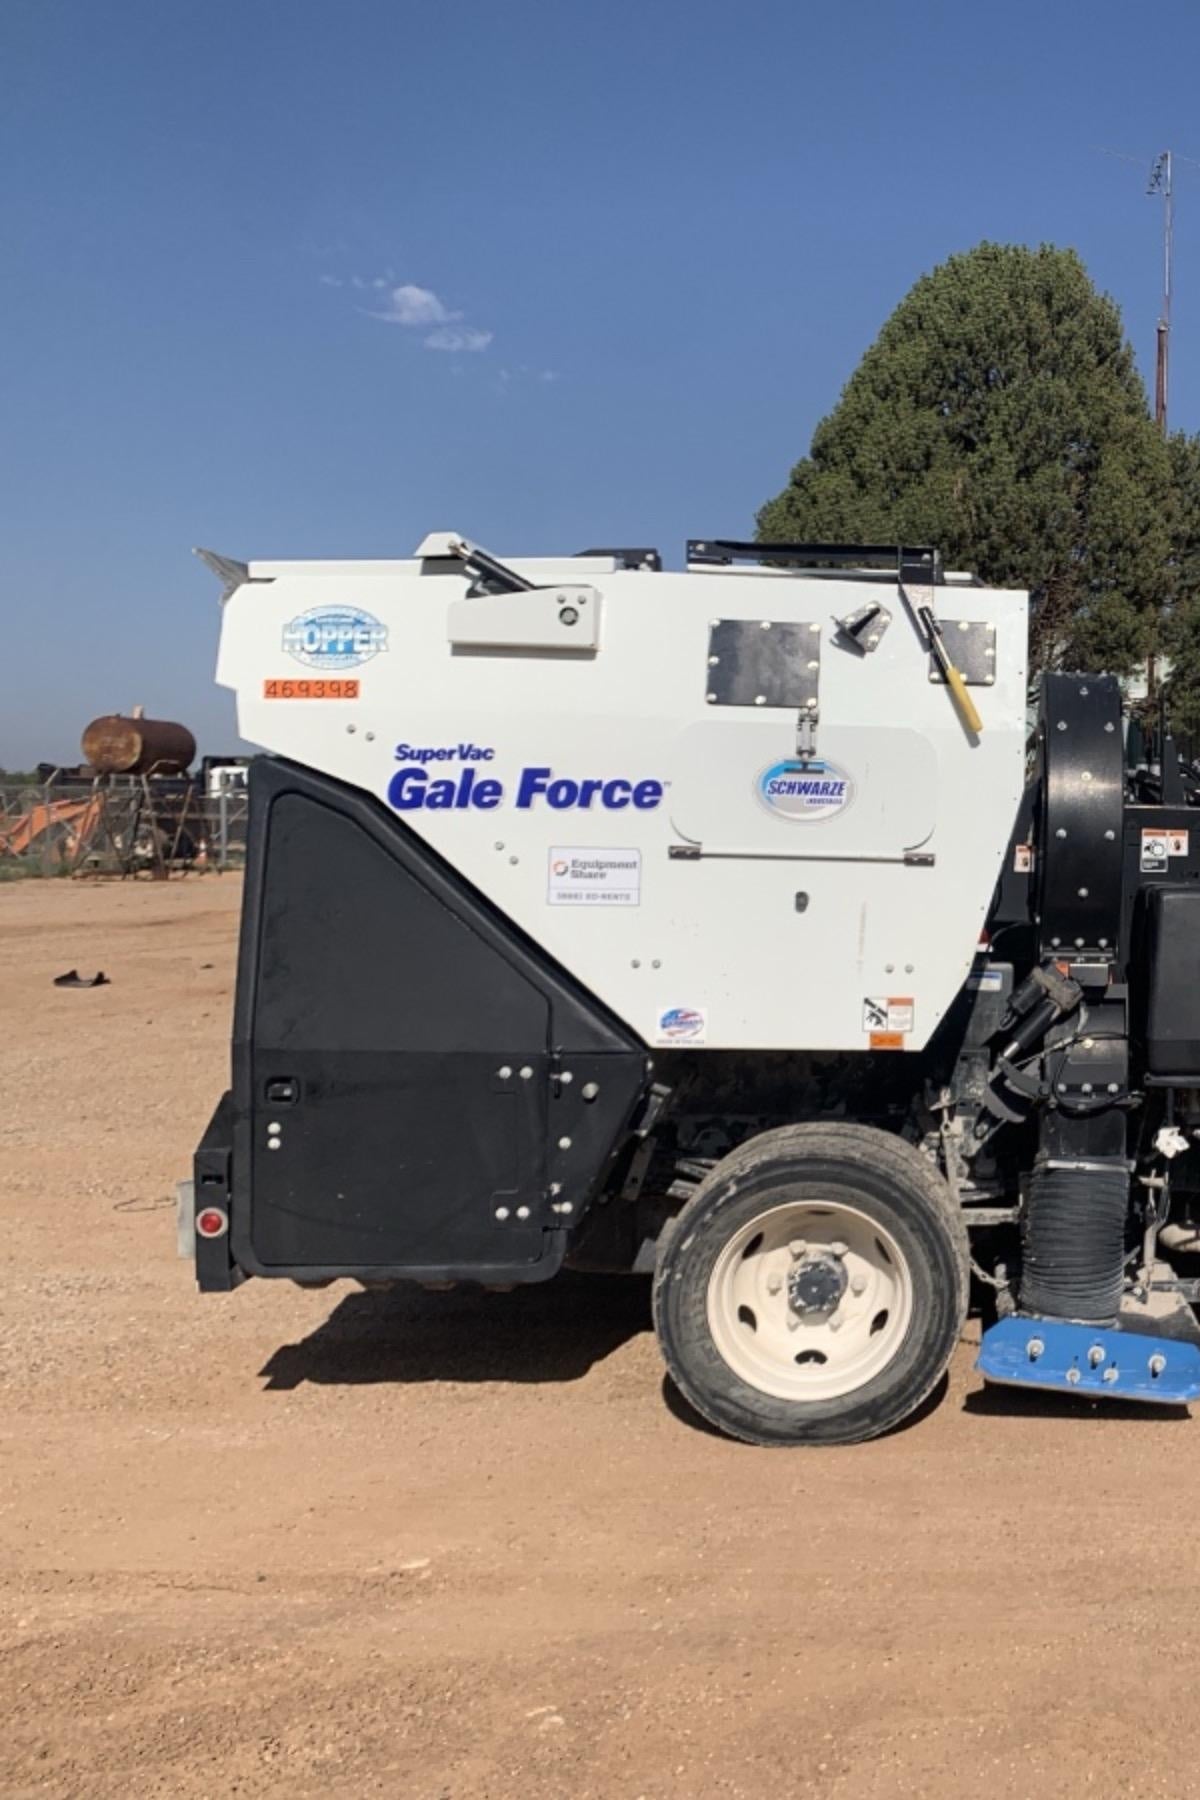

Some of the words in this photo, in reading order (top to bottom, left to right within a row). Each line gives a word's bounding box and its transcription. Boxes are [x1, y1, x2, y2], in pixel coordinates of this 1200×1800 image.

[282, 623, 388, 652] HOPPER
[265, 680, 358, 698] 469398
[387, 767, 504, 811] Gale
[515, 767, 664, 811] Force
[767, 780, 847, 796] SCHWARZE
